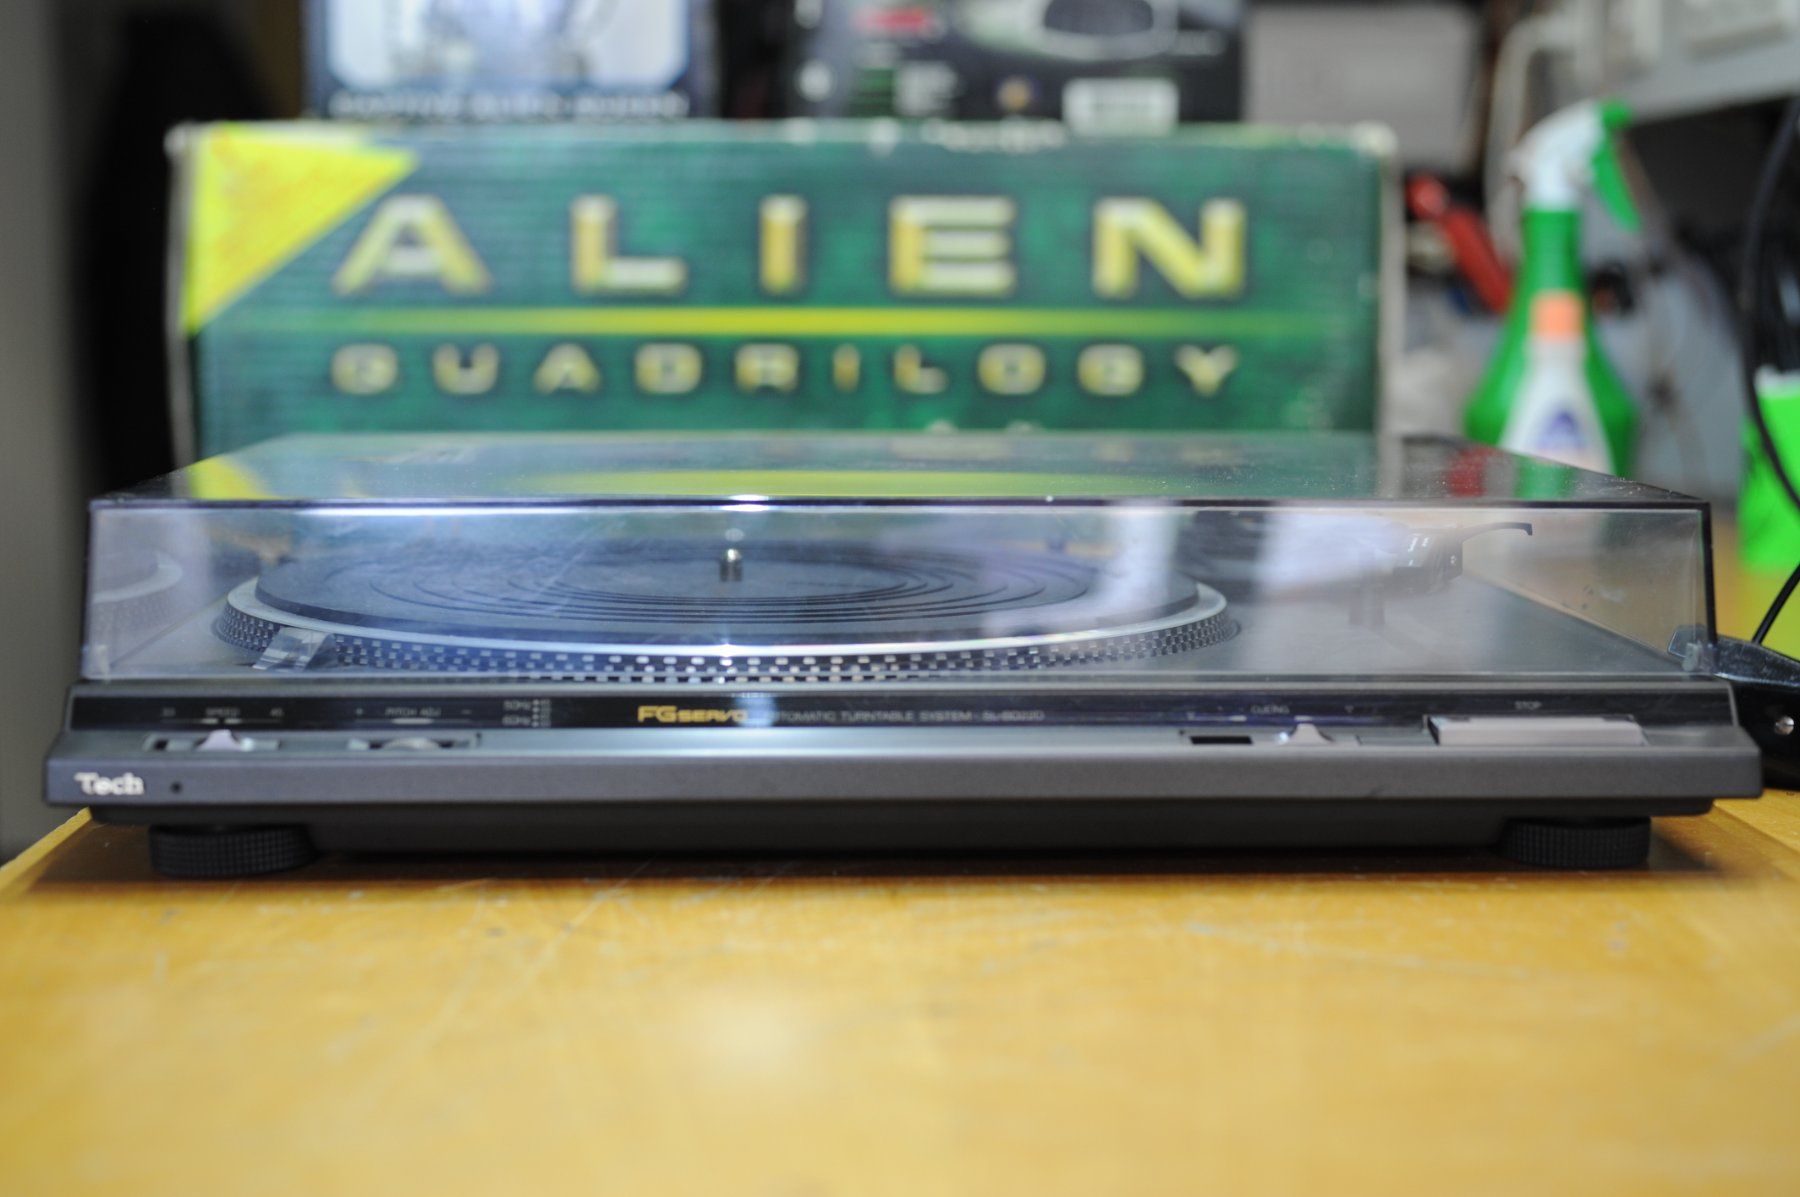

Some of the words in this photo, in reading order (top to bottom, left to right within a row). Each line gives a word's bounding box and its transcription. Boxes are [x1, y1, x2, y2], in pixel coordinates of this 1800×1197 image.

[331, 194, 1247, 296] ALIEN
[330, 343, 1239, 396] QUADRILOGY
[841, 710, 914, 722] TURNTABLE
[918, 710, 973, 722] SYSTEM
[74, 772, 144, 795] Tech
